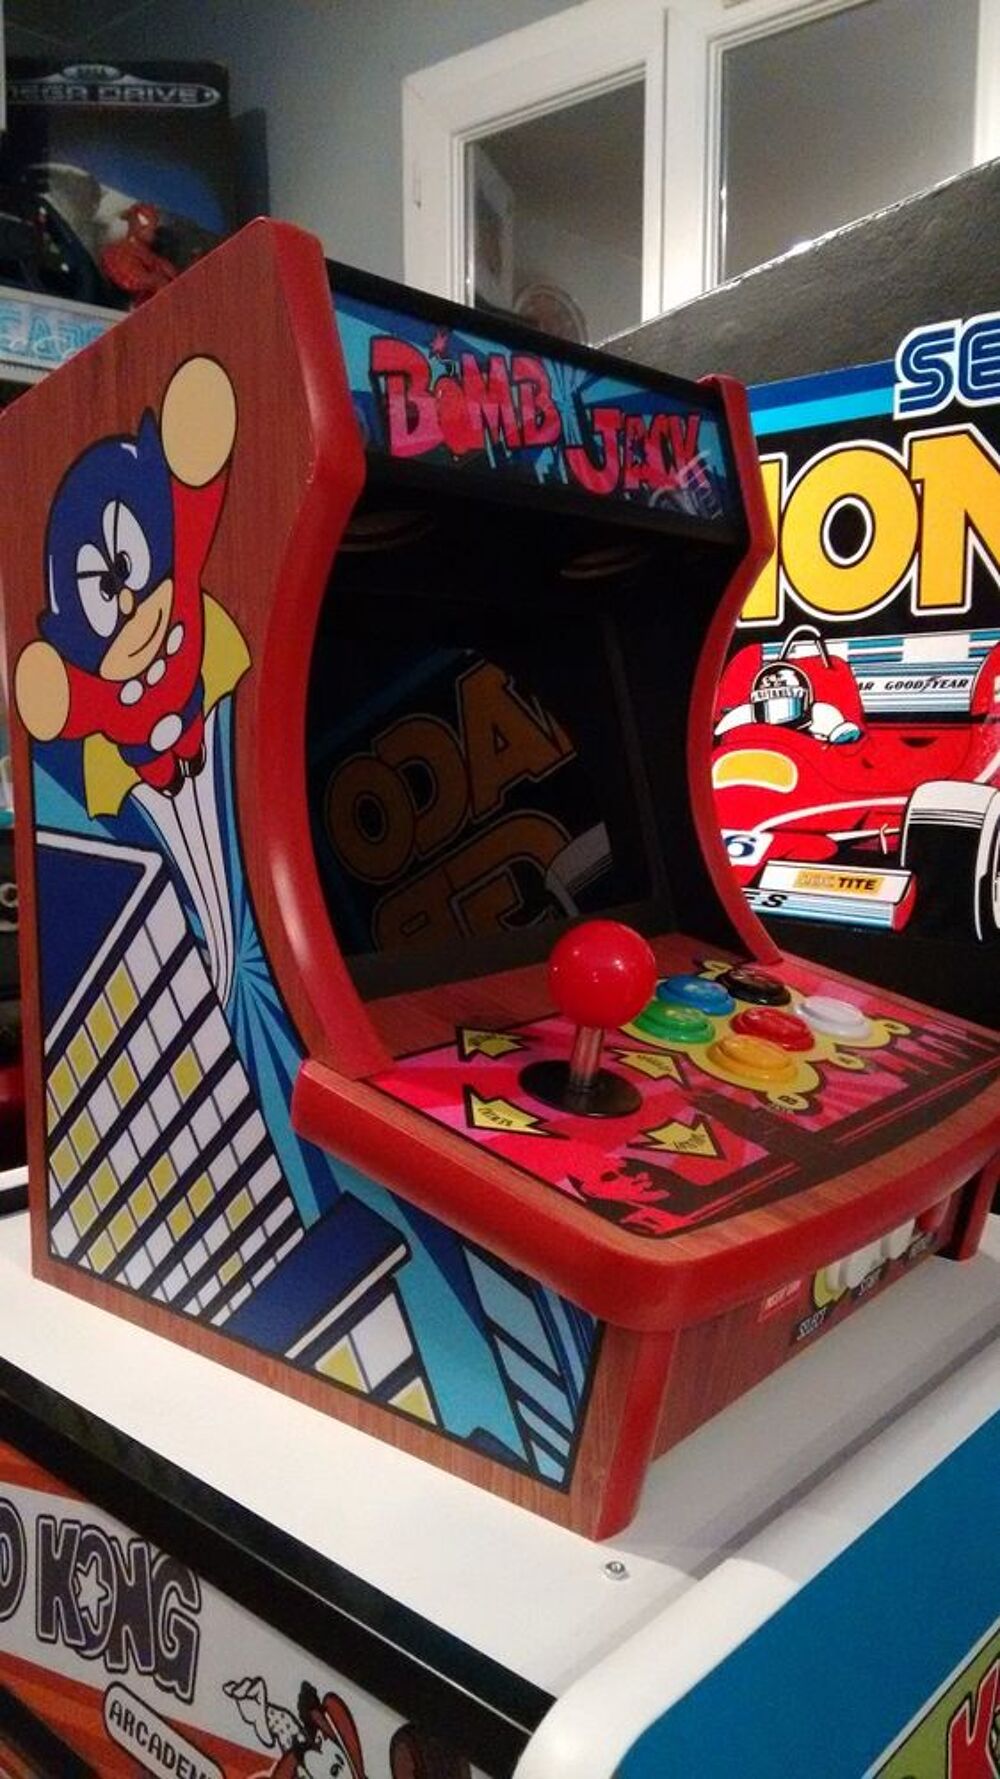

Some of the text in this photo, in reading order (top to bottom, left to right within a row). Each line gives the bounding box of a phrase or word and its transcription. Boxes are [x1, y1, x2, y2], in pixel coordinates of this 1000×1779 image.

[98, 84, 200, 101] DRIVE
[370, 334, 701, 494] BOMB JACK
[884, 677, 968, 691] GOODYEAR
[36, 1513, 201, 1705] KONG
